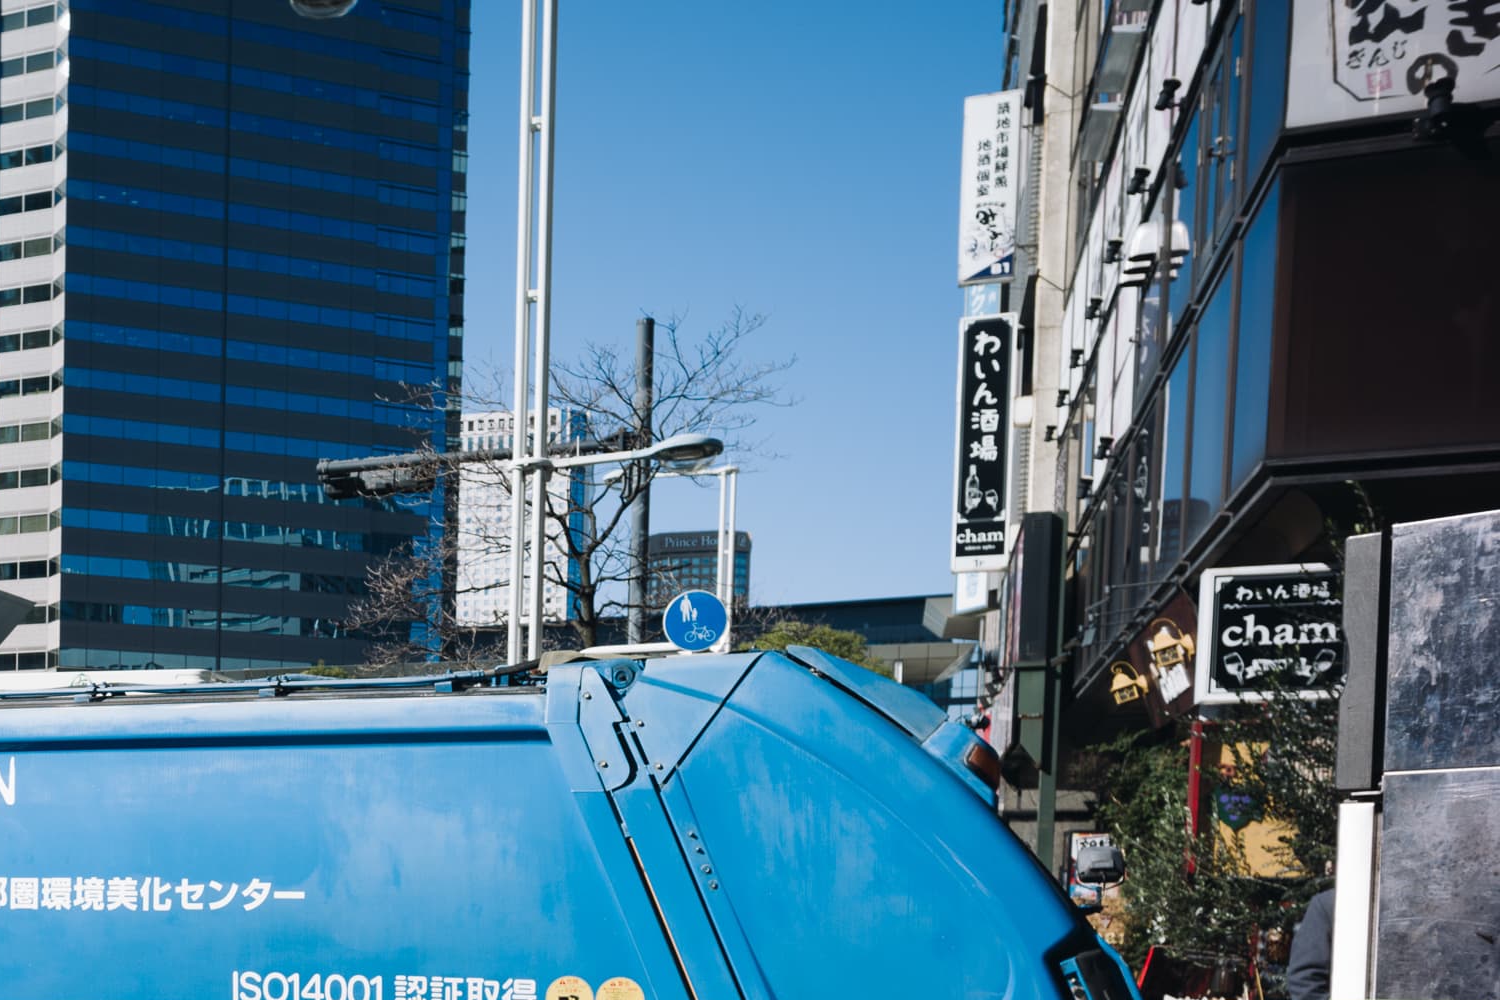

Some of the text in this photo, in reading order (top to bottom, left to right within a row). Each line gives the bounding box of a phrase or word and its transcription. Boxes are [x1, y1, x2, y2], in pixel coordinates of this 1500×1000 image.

[970, 330, 1001, 461] わいん酒場
[664, 536, 698, 548] Prince
[956, 528, 1005, 544] cham
[1235, 580, 1331, 602] わいん酒場
[1221, 613, 1341, 648] cham
